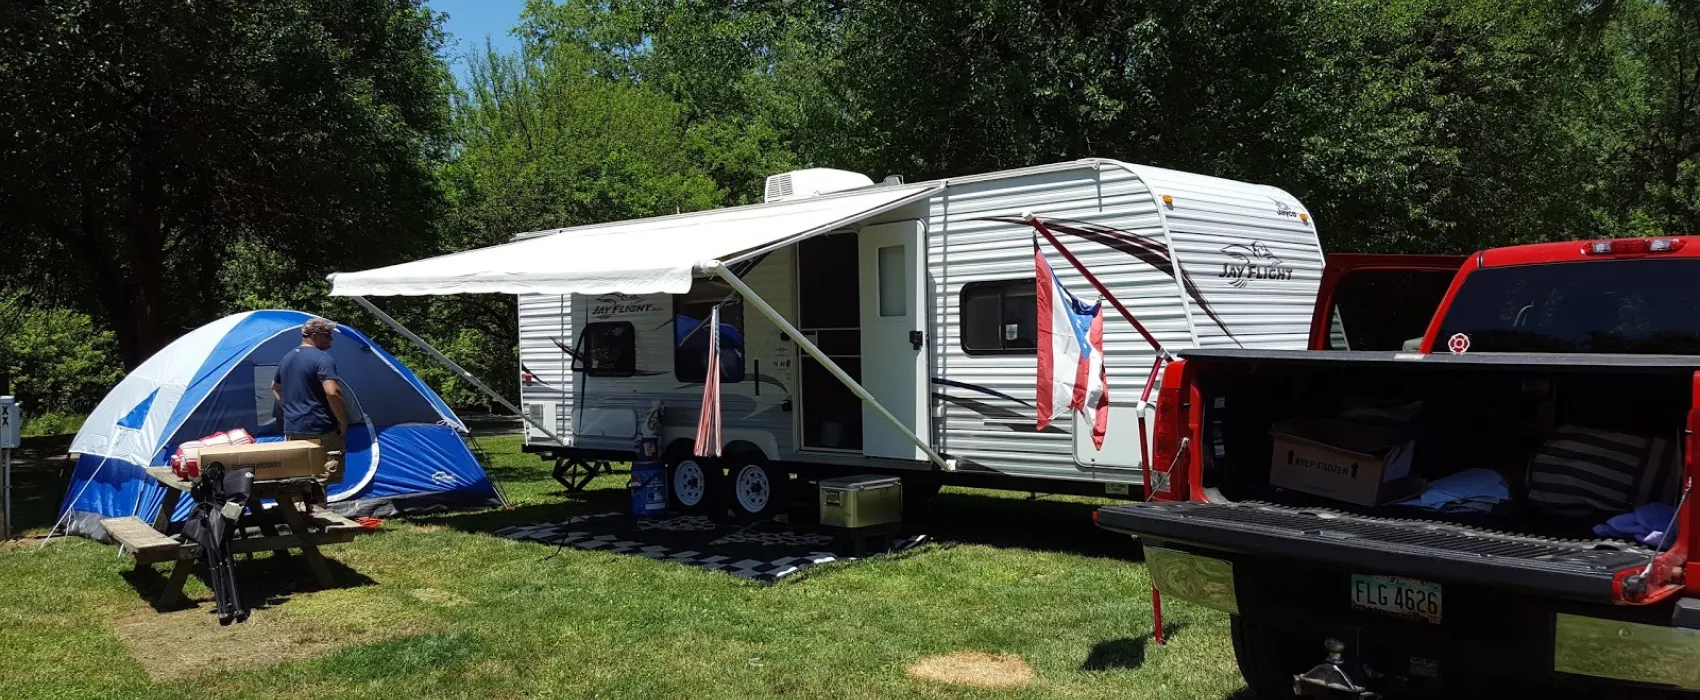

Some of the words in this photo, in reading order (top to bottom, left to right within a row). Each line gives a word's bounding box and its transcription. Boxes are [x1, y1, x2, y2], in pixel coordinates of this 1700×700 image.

[1218, 263, 1246, 278] JAY
[1247, 264, 1293, 280] FLIGHT
[591, 305, 611, 315] JAY
[611, 303, 653, 313] FLIGHT
[1316, 462, 1349, 476] FROZEN
[1355, 580, 1388, 606] FLG
[1394, 586, 1438, 615] 4626
